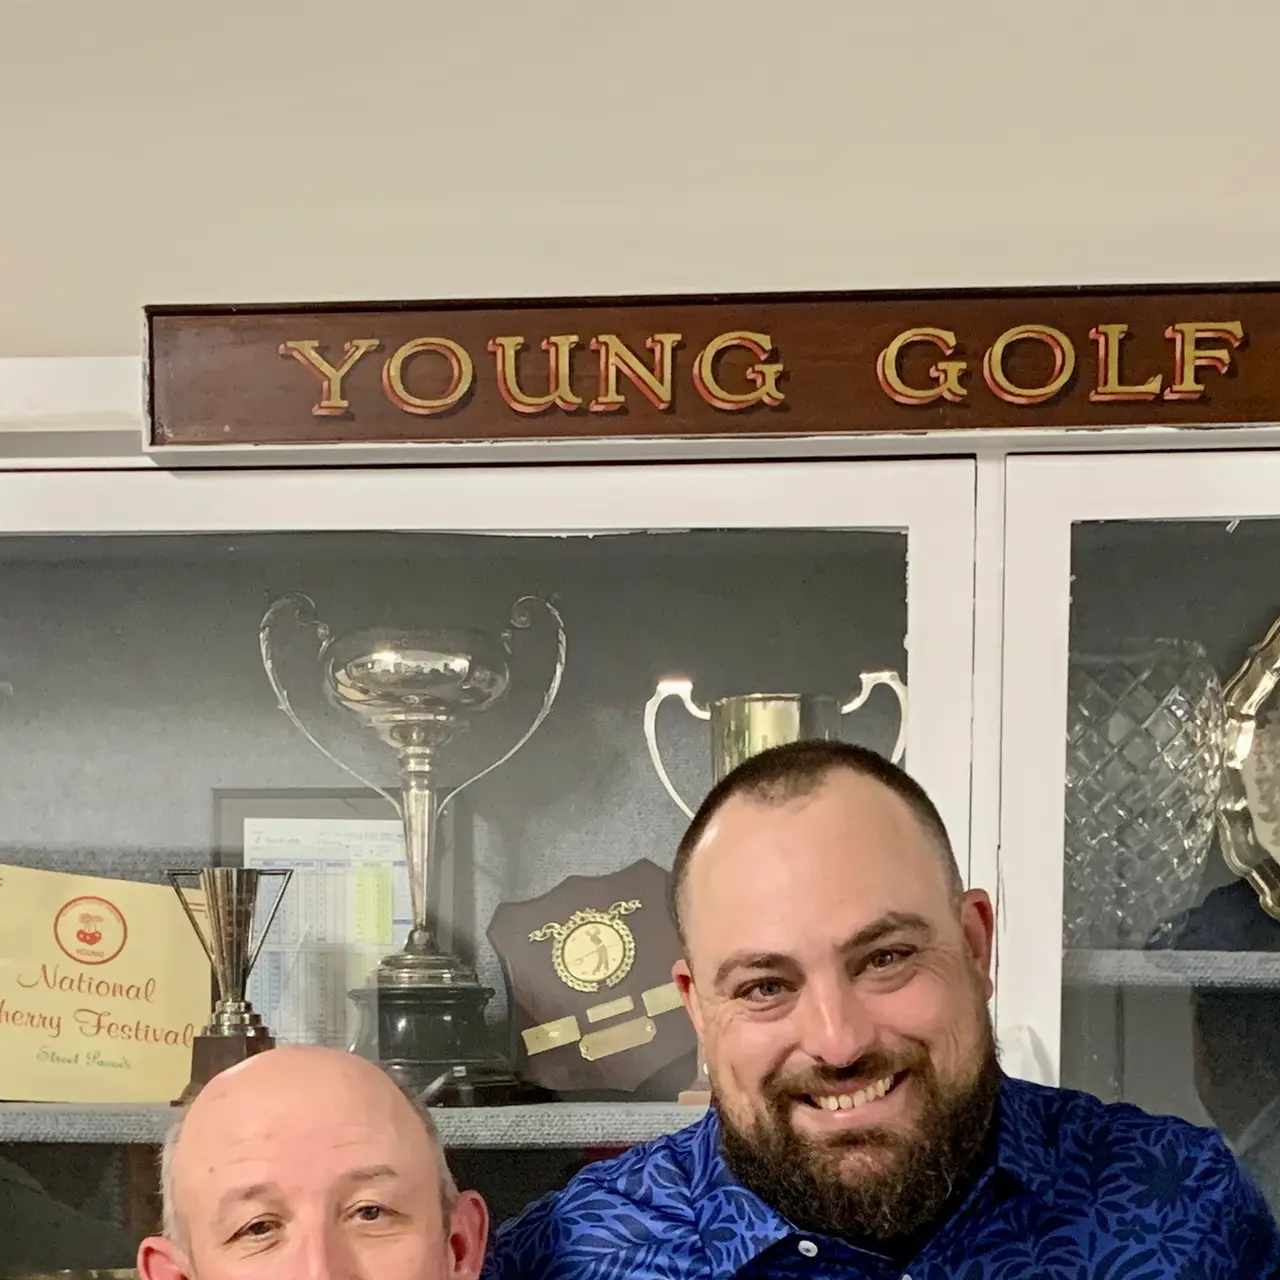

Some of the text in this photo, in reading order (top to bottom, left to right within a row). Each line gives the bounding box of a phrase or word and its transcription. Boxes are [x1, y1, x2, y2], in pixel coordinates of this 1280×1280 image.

[278, 330, 786, 415] YOUNG
[877, 320, 1244, 404] GOLF
[17, 963, 156, 1003] National
[73, 1008, 195, 1048] Festival
